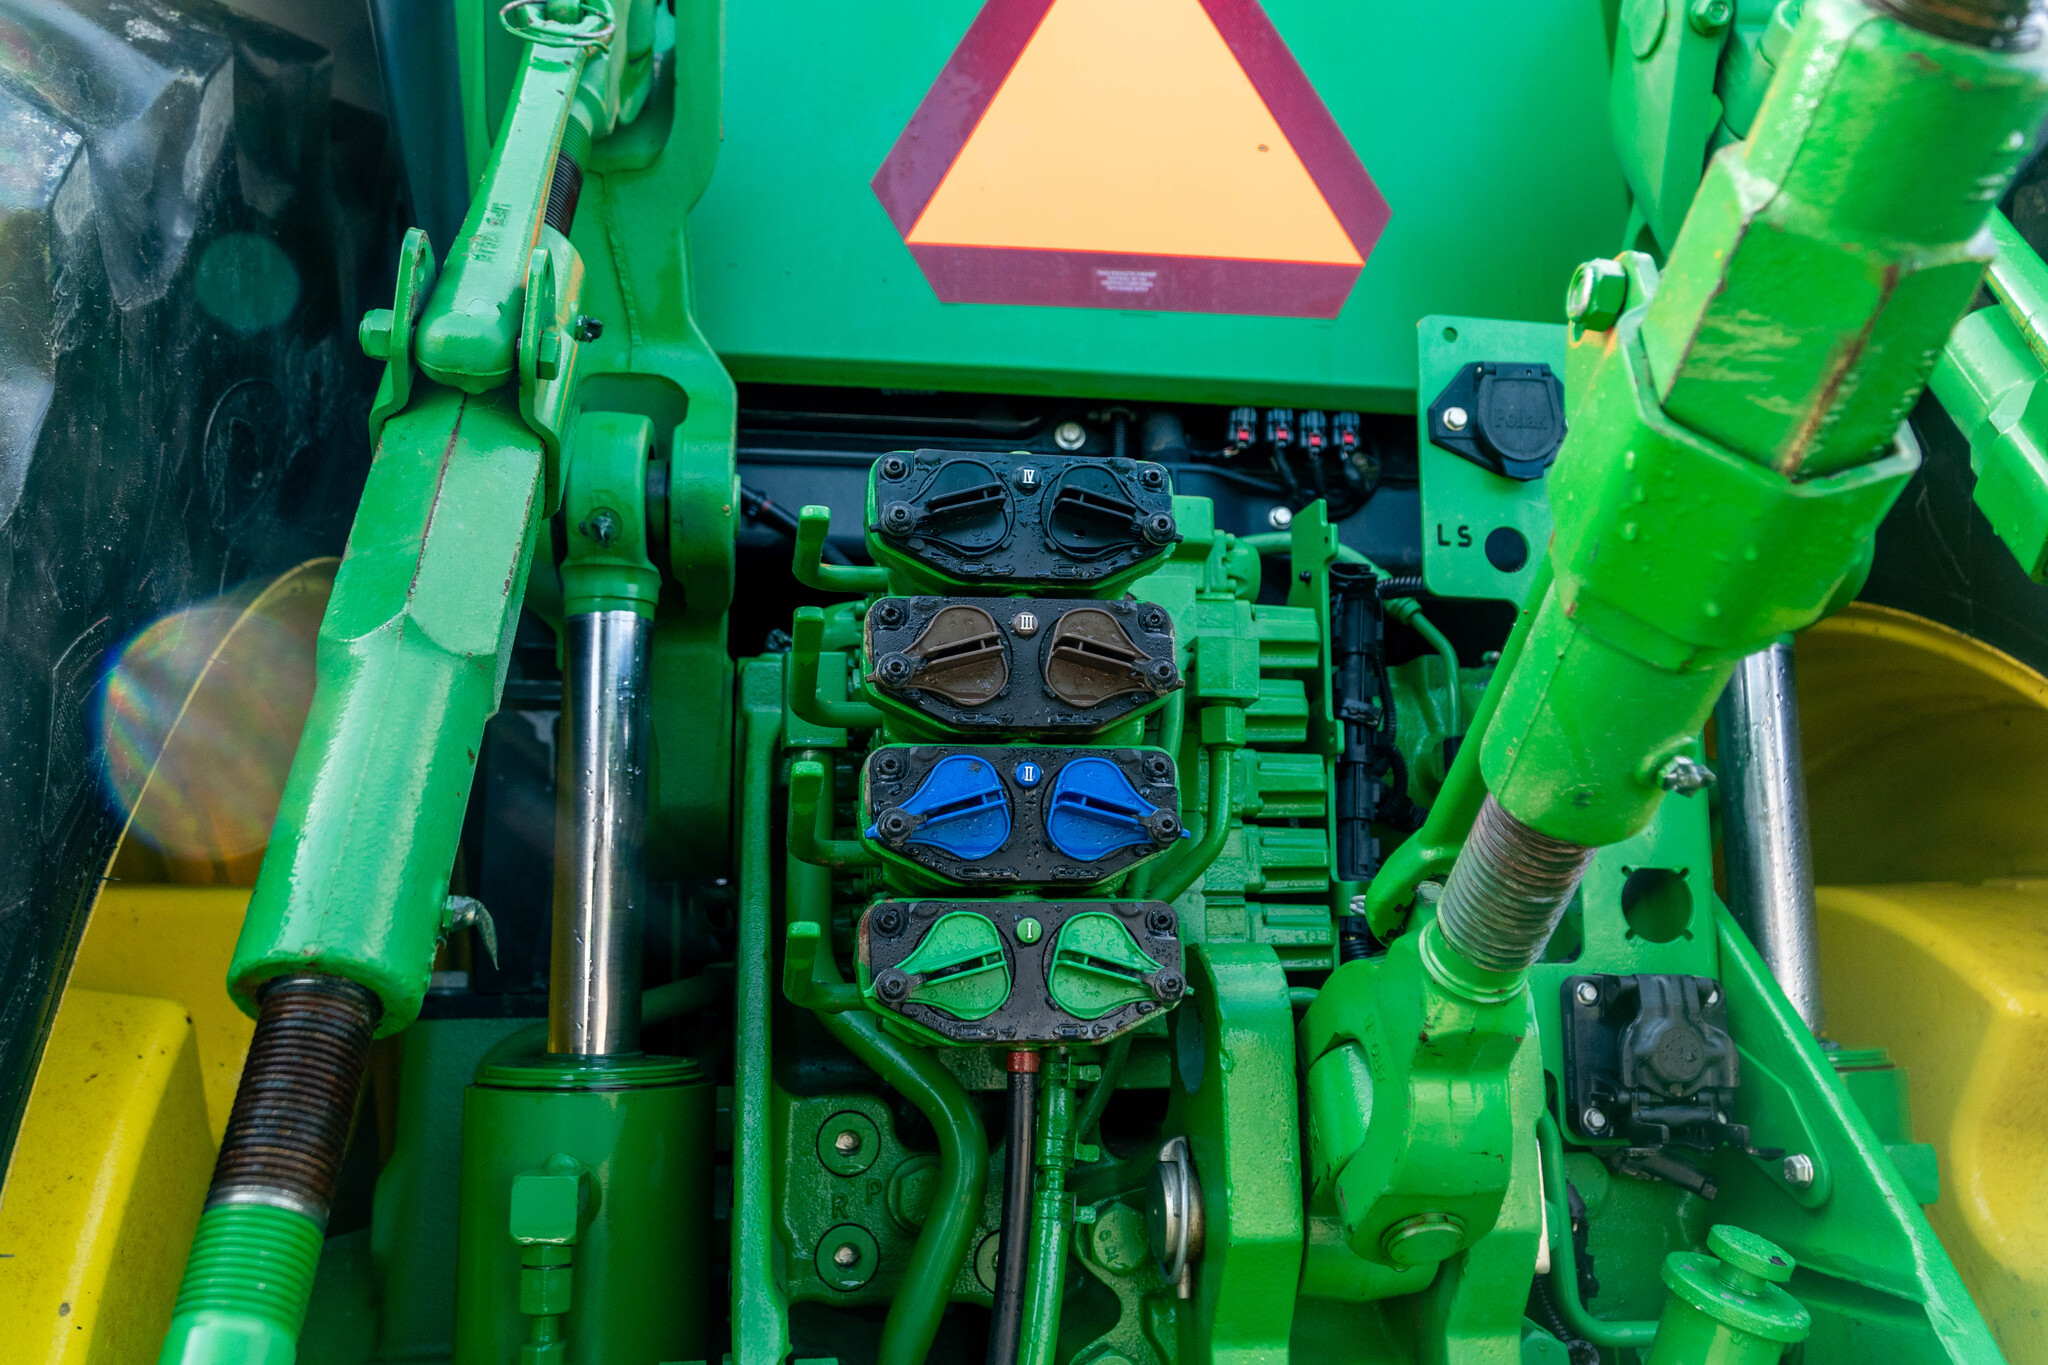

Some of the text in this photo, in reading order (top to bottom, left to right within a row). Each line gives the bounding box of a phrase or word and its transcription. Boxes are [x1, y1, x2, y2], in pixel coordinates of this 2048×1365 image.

[1494, 407, 1549, 431] Pollak
[1022, 468, 1035, 484] IV
[1020, 614, 1034, 630] III
[1024, 765, 1034, 782] II
[866, 1179, 882, 1205] P
[832, 1193, 849, 1219] R
